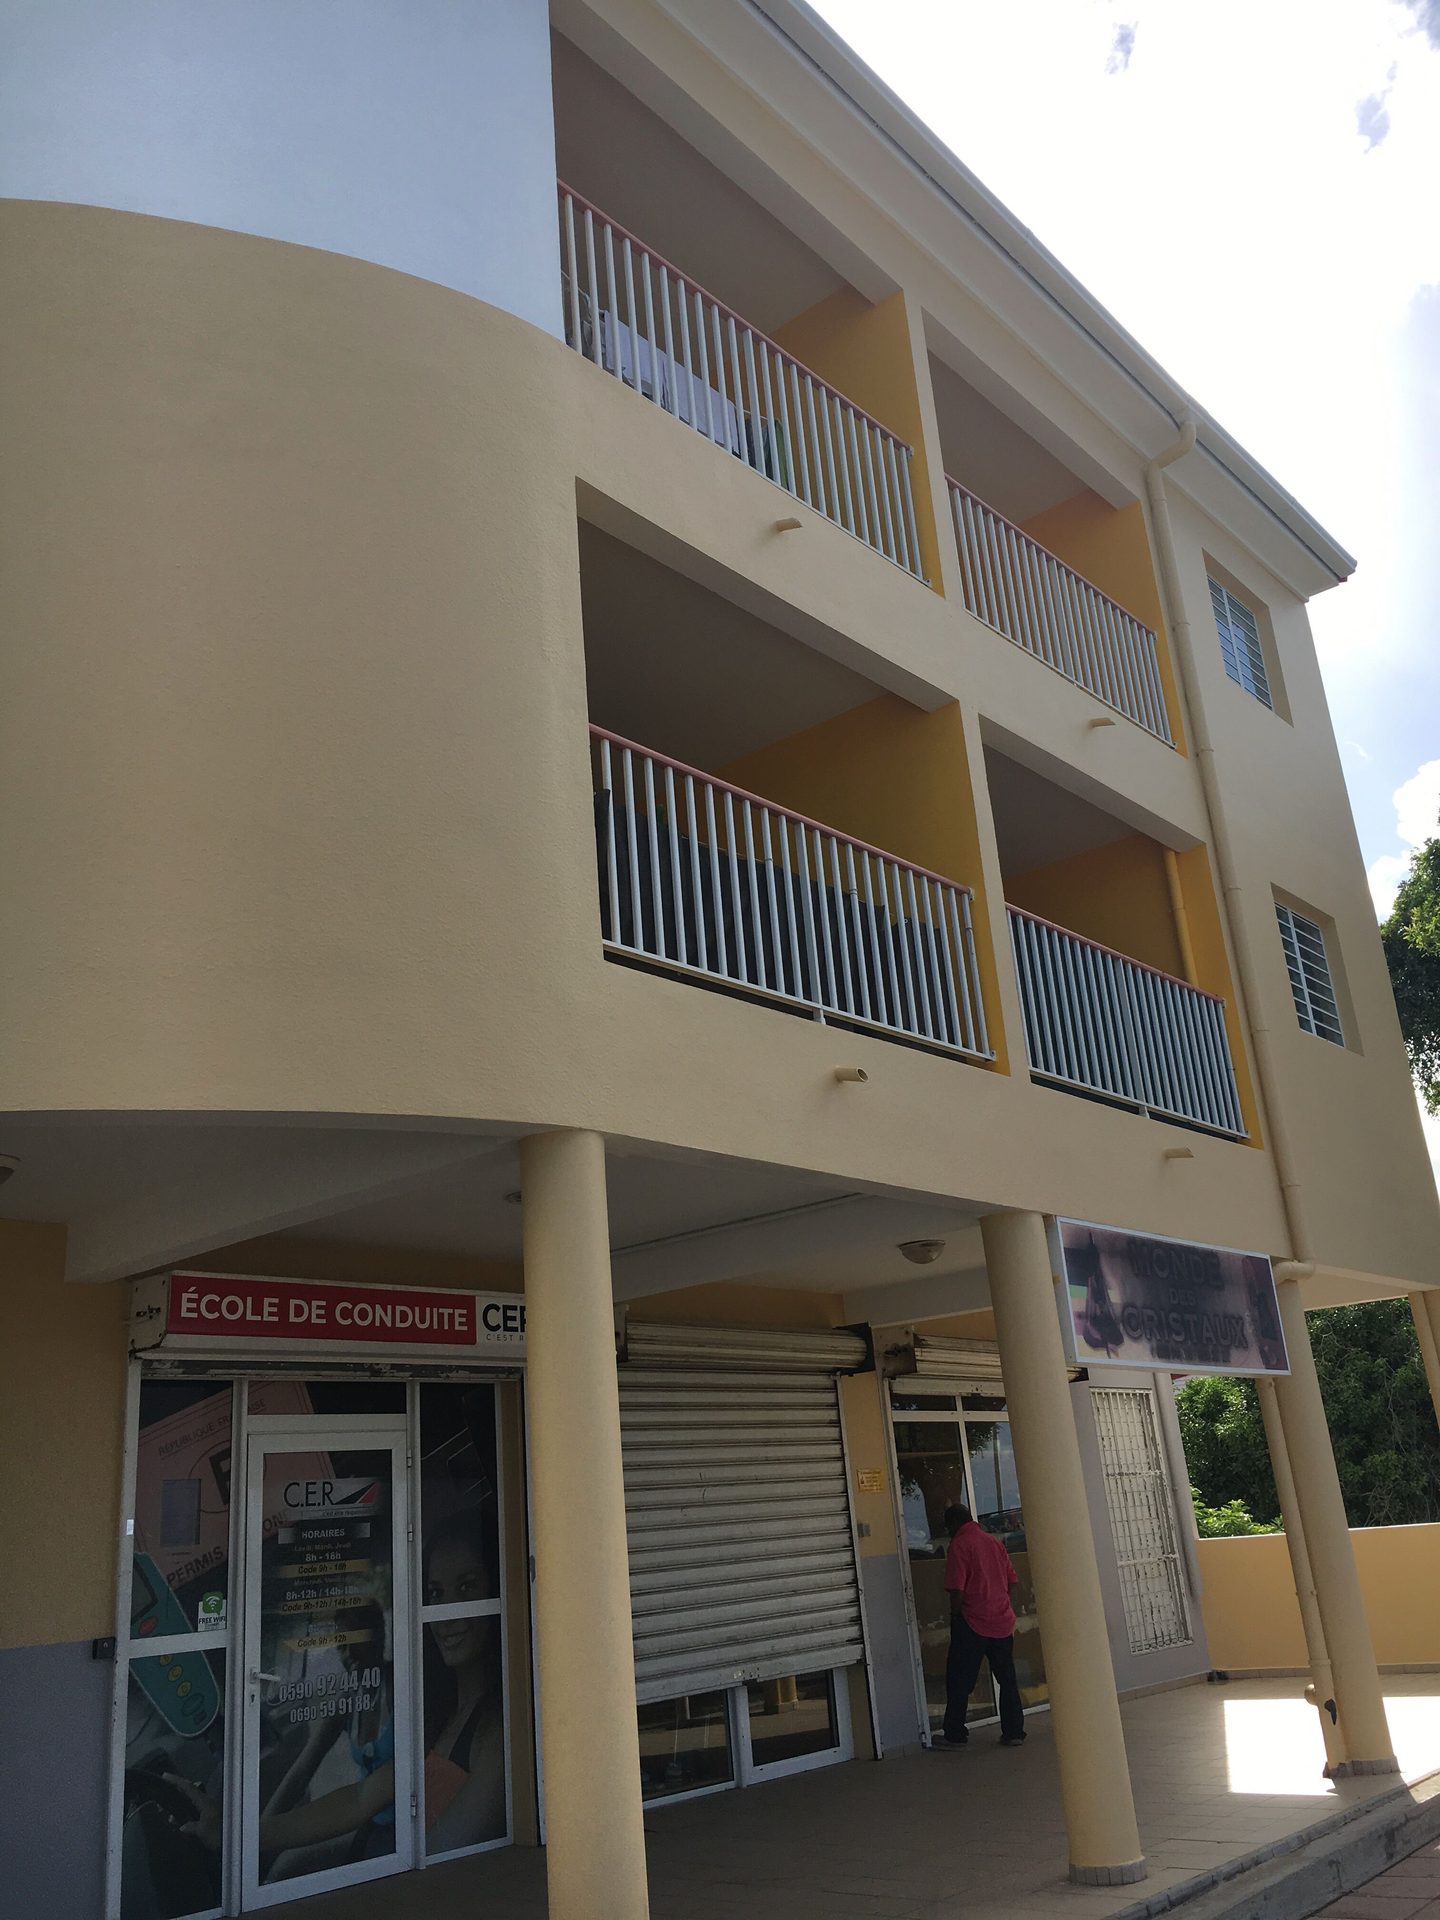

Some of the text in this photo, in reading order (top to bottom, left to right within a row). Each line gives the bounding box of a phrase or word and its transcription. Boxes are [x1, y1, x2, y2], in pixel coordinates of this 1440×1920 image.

[1131, 1244, 1223, 1286] MONDE
[1169, 1288, 1196, 1306] DES
[180, 1286, 468, 1331] ÉCOLE DE CONDUITE
[1123, 1306, 1248, 1347] CRISTAUX
[283, 1481, 336, 1508] C.E.R
[301, 1528, 345, 1539] HORAIRES
[166, 1546, 224, 1584] PERMIS
[305, 1553, 317, 1561] 8h
[298, 1565, 317, 1574] Code
[286, 1589, 317, 1600] 8h-12h
[281, 1603, 302, 1612] Code
[198, 1615, 226, 1625] FREE WIFI
[297, 1638, 317, 1648] Code
[318, 1637, 328, 1645] 9h
[334, 1633, 347, 1643] 12h
[278, 1666, 381, 1703] 0590 92 44 40
[289, 1694, 371, 1723] 0690 59 91 88
